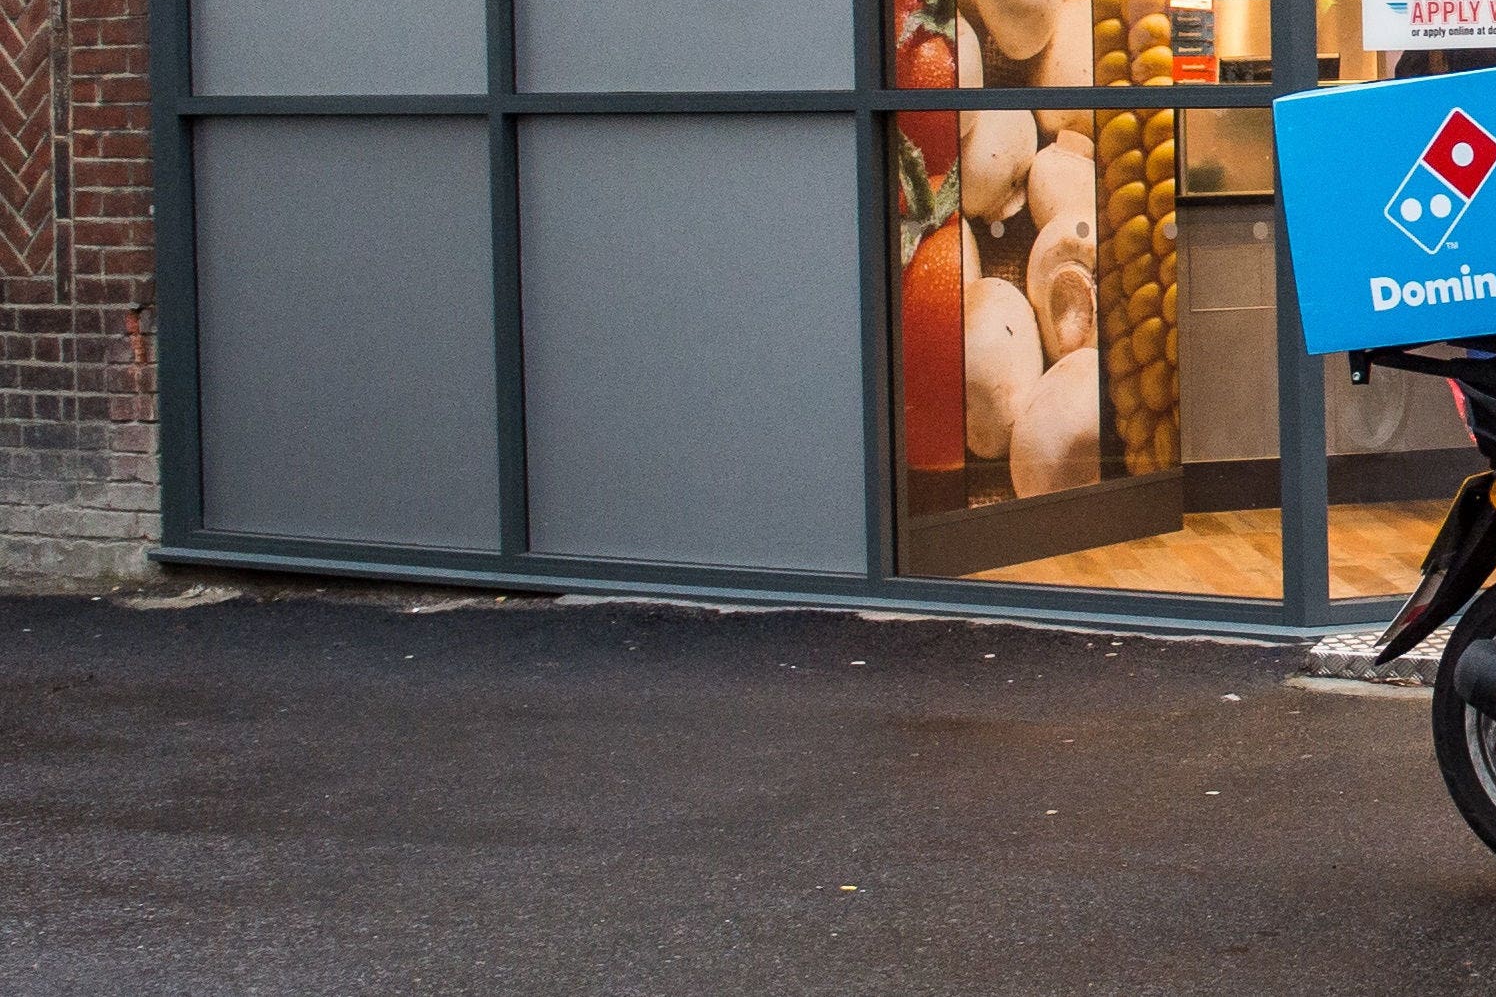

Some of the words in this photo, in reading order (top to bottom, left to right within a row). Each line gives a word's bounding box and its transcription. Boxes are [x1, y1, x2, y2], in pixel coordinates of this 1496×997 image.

[1411, 0, 1481, 24] APPLY
[1411, 28, 1420, 37] or
[1423, 26, 1446, 38] apply
[1448, 25, 1474, 36] online
[1477, 26, 1486, 35] at
